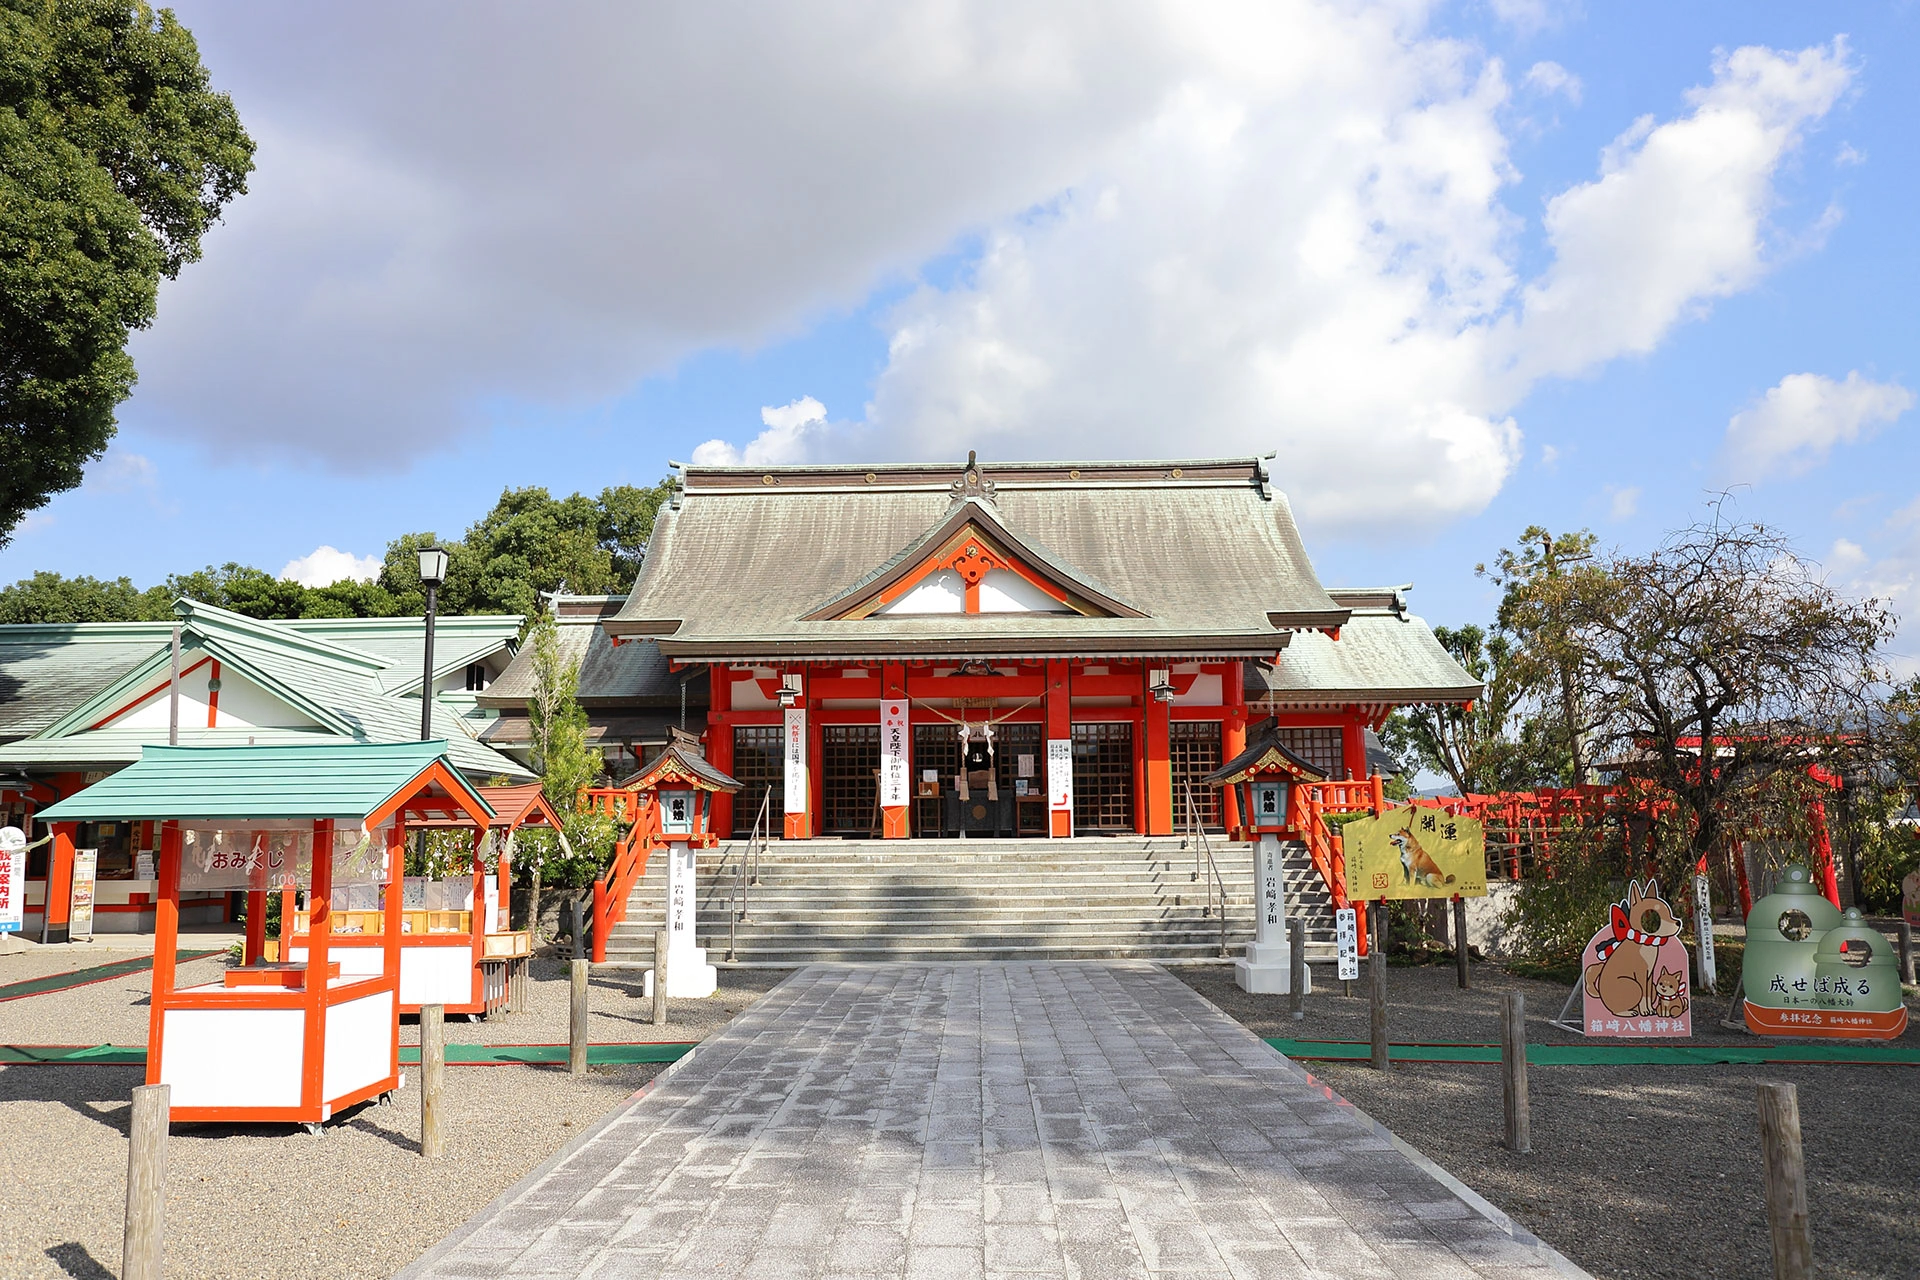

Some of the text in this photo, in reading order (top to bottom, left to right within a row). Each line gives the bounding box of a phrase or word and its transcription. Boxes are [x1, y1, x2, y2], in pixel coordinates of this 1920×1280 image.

[1420, 814, 1458, 841] 開運
[212, 850, 285, 869] おみくじ
[1769, 974, 1871, 996] 成せば成る
[1783, 996, 1855, 1007] 日本一の八幡大鈴
[1779, 1013, 1823, 1025] 参拝記念
